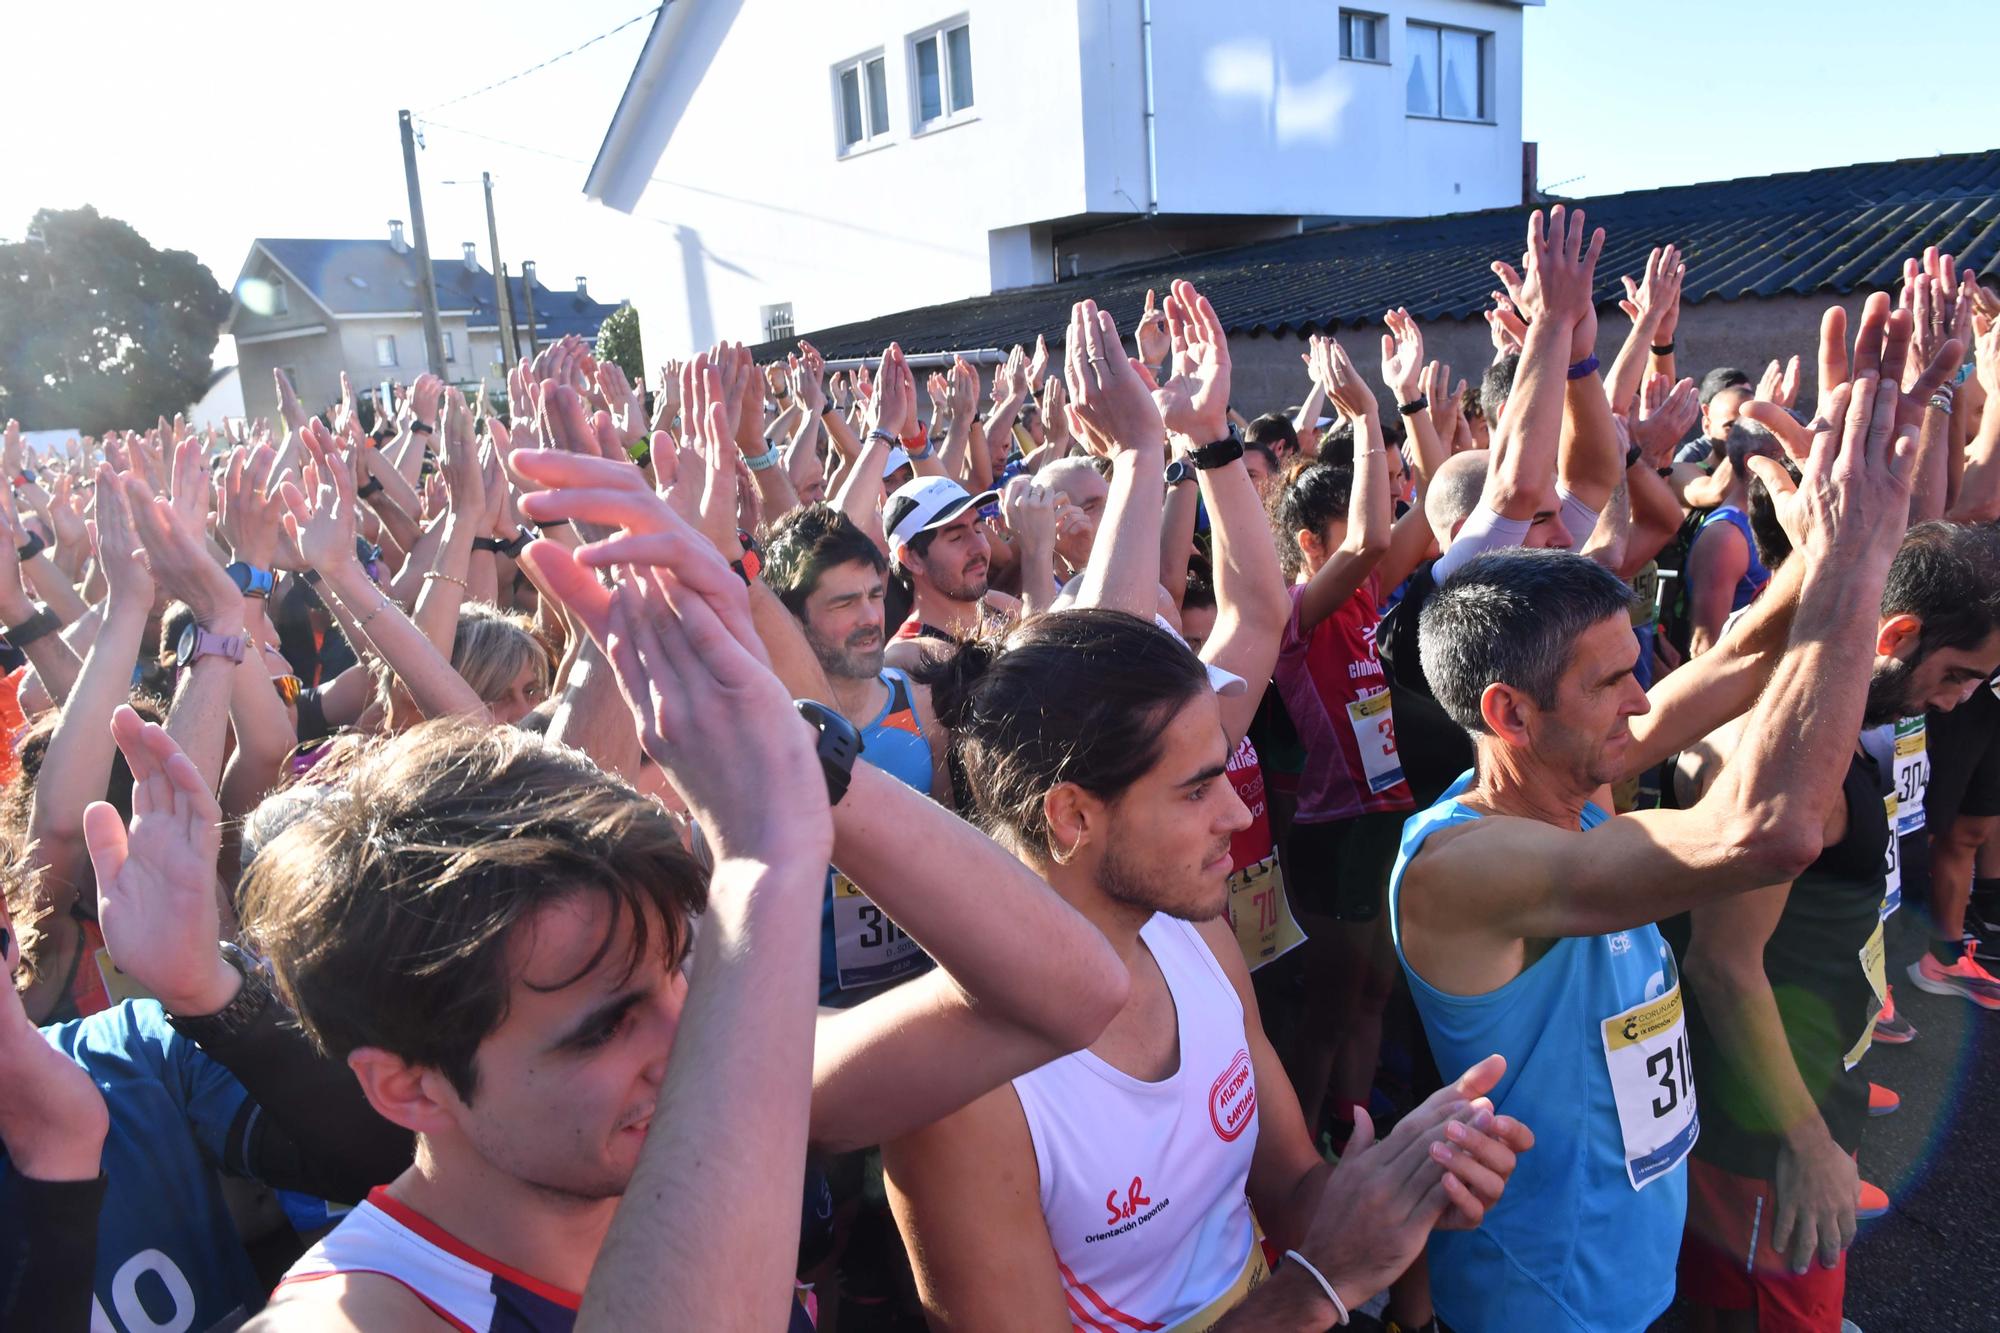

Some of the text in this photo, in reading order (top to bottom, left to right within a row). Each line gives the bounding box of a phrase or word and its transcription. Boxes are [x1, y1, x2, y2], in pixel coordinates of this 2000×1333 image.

[1251, 886, 1278, 933] 70
[1220, 1064, 1249, 1109] ATLETISMO
[1227, 1086, 1254, 1129] SANTIAGO
[1085, 1198, 1170, 1244] Orientación Deportiva
[1106, 1176, 1151, 1226] S&R
